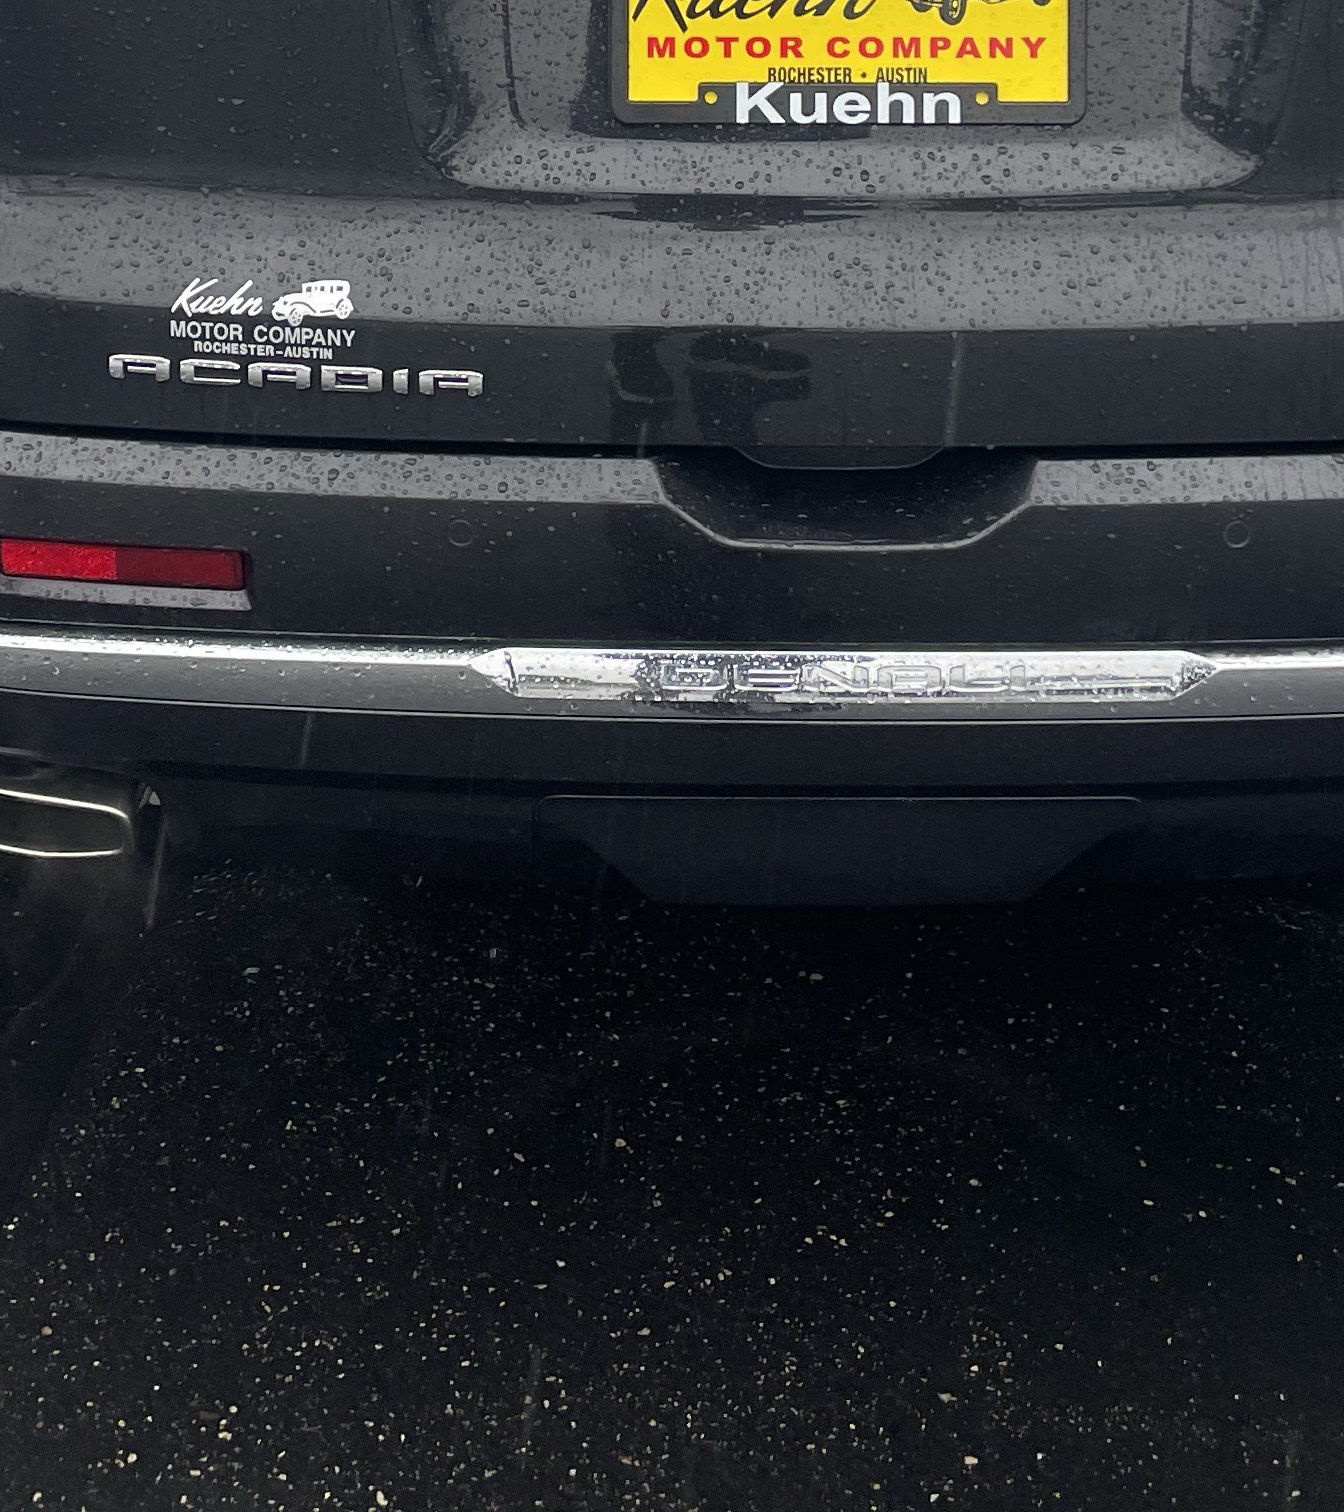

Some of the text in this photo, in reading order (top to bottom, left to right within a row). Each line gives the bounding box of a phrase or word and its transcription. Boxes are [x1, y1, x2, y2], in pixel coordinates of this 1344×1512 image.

[647, 36, 1047, 59] MOTOR COMPANY
[768, 67, 928, 83] ROCHESTER AUSTIN
[735, 82, 962, 124] Kuehn
[171, 278, 263, 317] Kuehn
[170, 320, 356, 347] MOTOR COMPANY
[194, 341, 333, 360] ROCHESTER-AUSTIN
[109, 354, 483, 397] ACADIA
[660, 662, 1026, 693] DENALI
